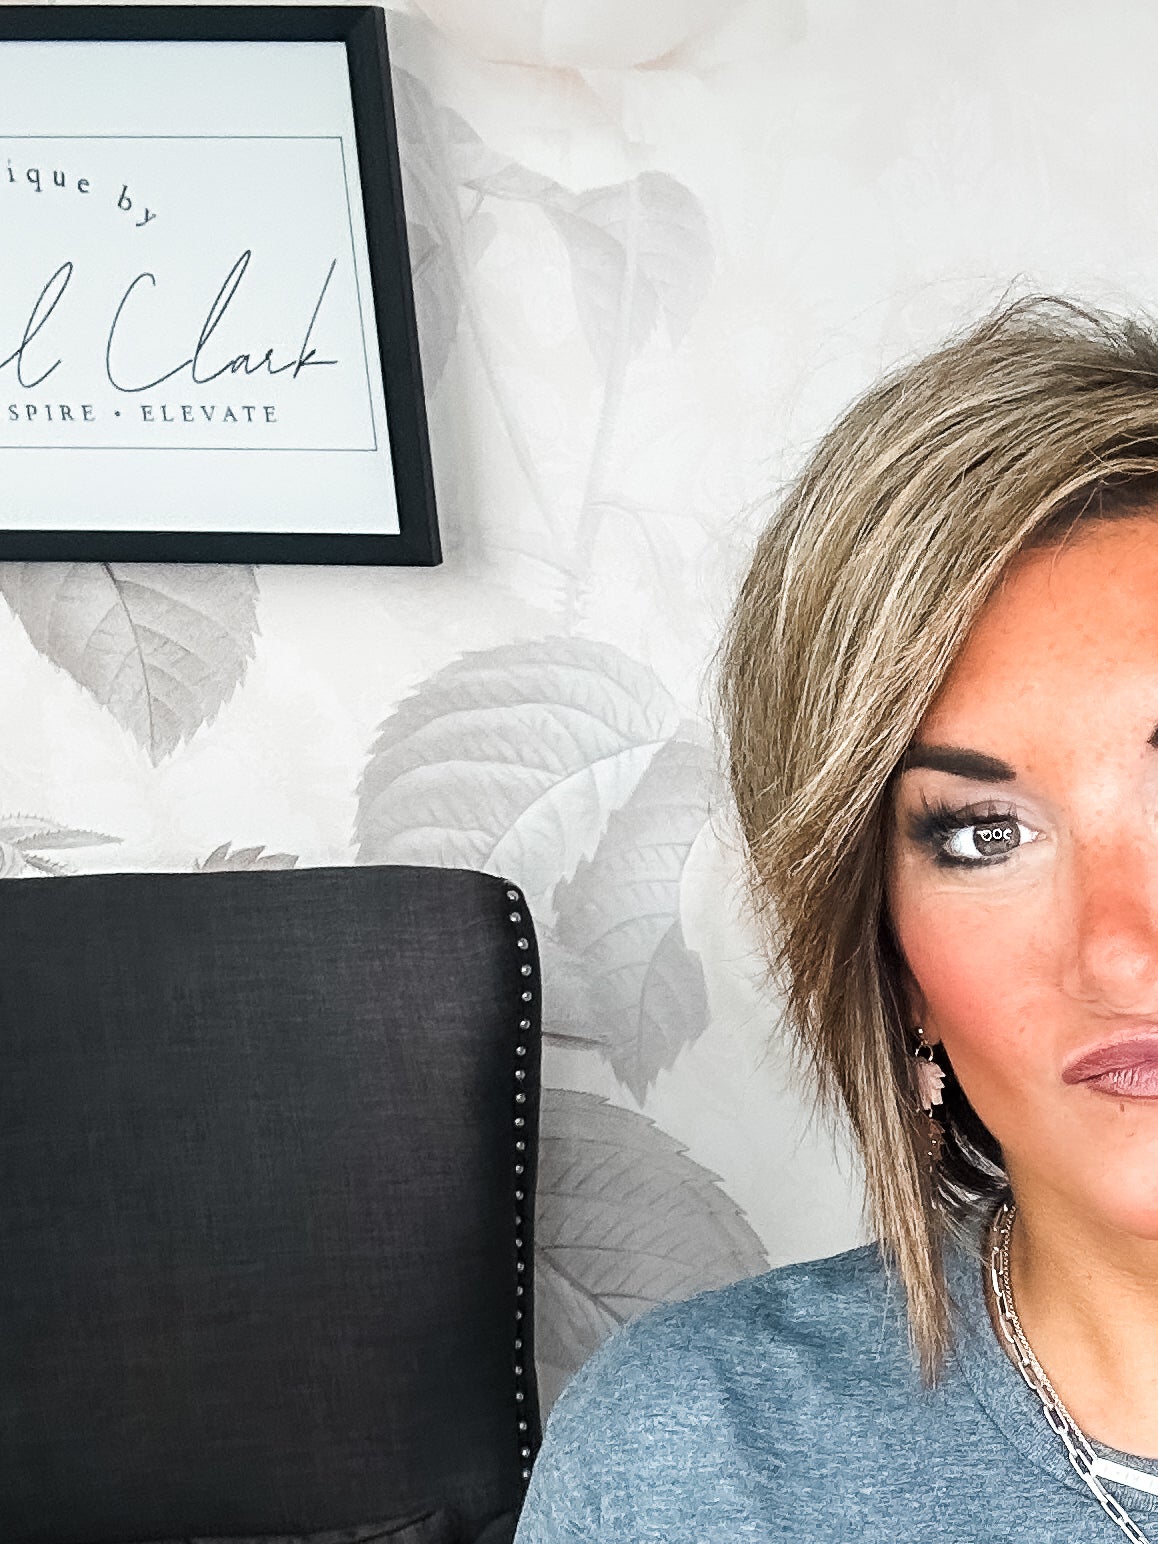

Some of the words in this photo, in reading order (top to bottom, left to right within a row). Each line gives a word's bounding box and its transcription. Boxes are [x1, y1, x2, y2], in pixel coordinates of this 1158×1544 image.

[6, 158, 91, 193] ique
[117, 185, 157, 227] by
[106, 249, 338, 392] Clark
[8, 404, 97, 422] SPIRE
[140, 405, 279, 423] ELEVATE
